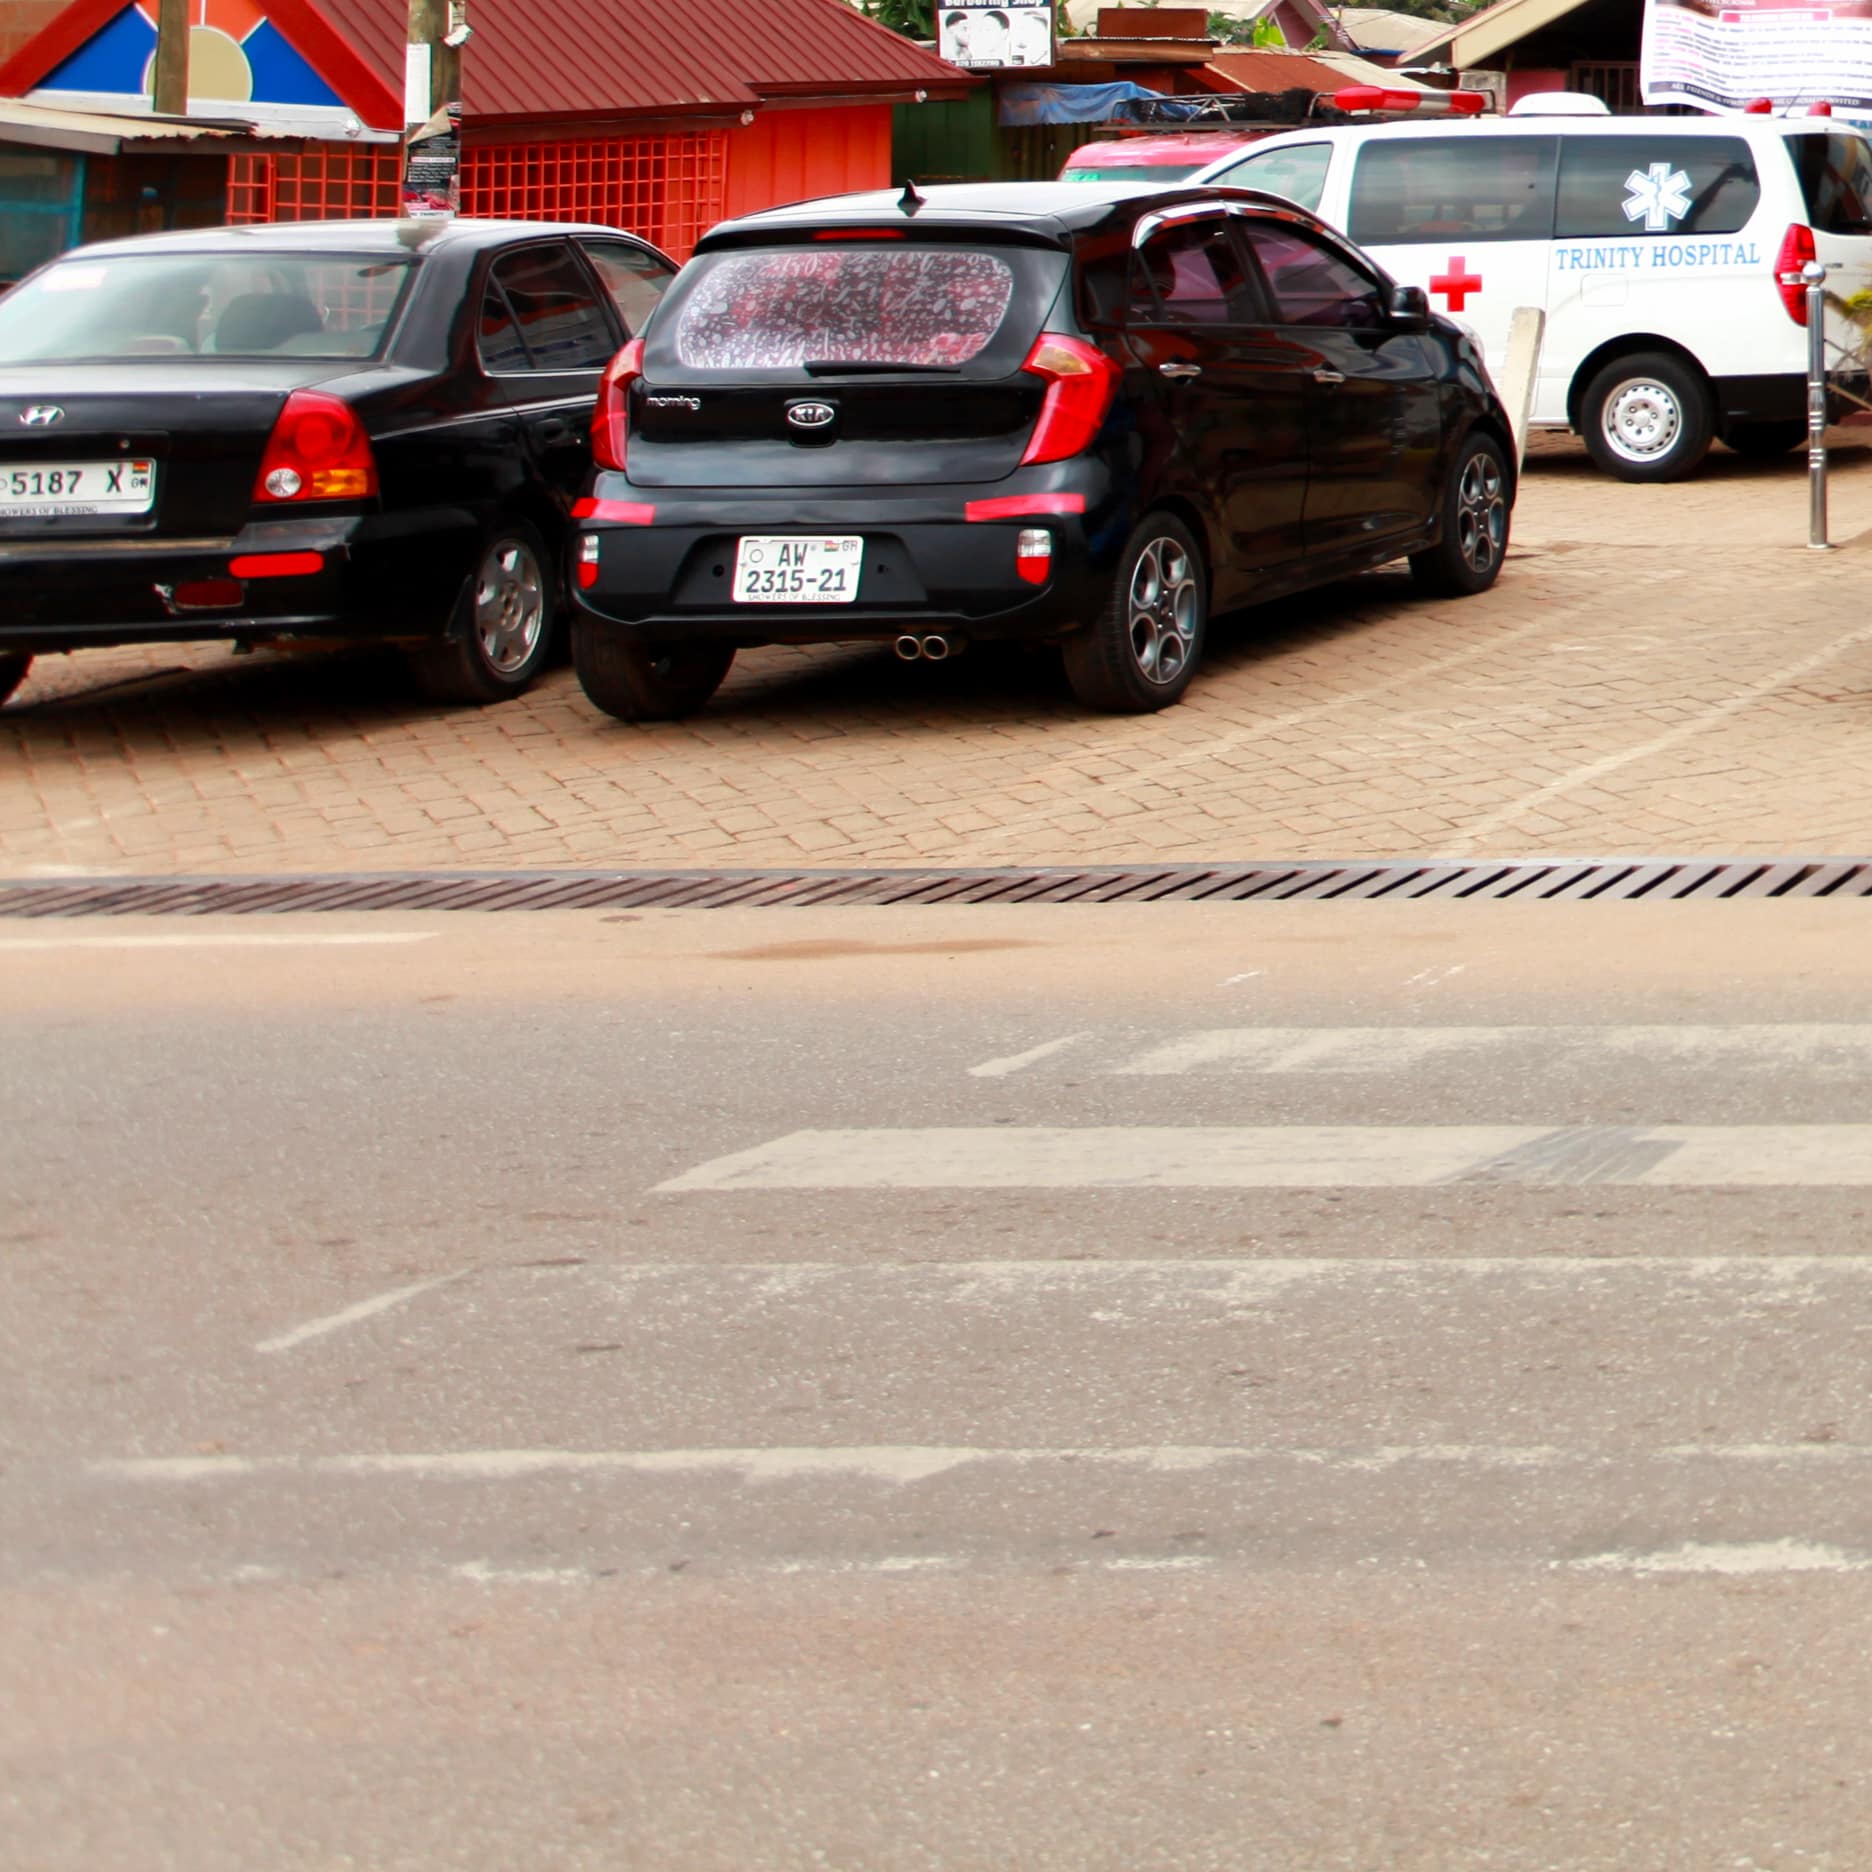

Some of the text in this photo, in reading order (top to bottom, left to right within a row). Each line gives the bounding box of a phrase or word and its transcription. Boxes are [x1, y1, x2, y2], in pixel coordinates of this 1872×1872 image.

[1556, 243, 1761, 270] TRINITY HOSPITAL
[647, 394, 701, 410] morning
[11, 470, 83, 496] 5187
[106, 463, 124, 493] X
[39, 507, 50, 516] OF
[54, 505, 98, 515] BLESSING
[778, 540, 858, 567] AW GH
[746, 568, 846, 593] 2315-21
